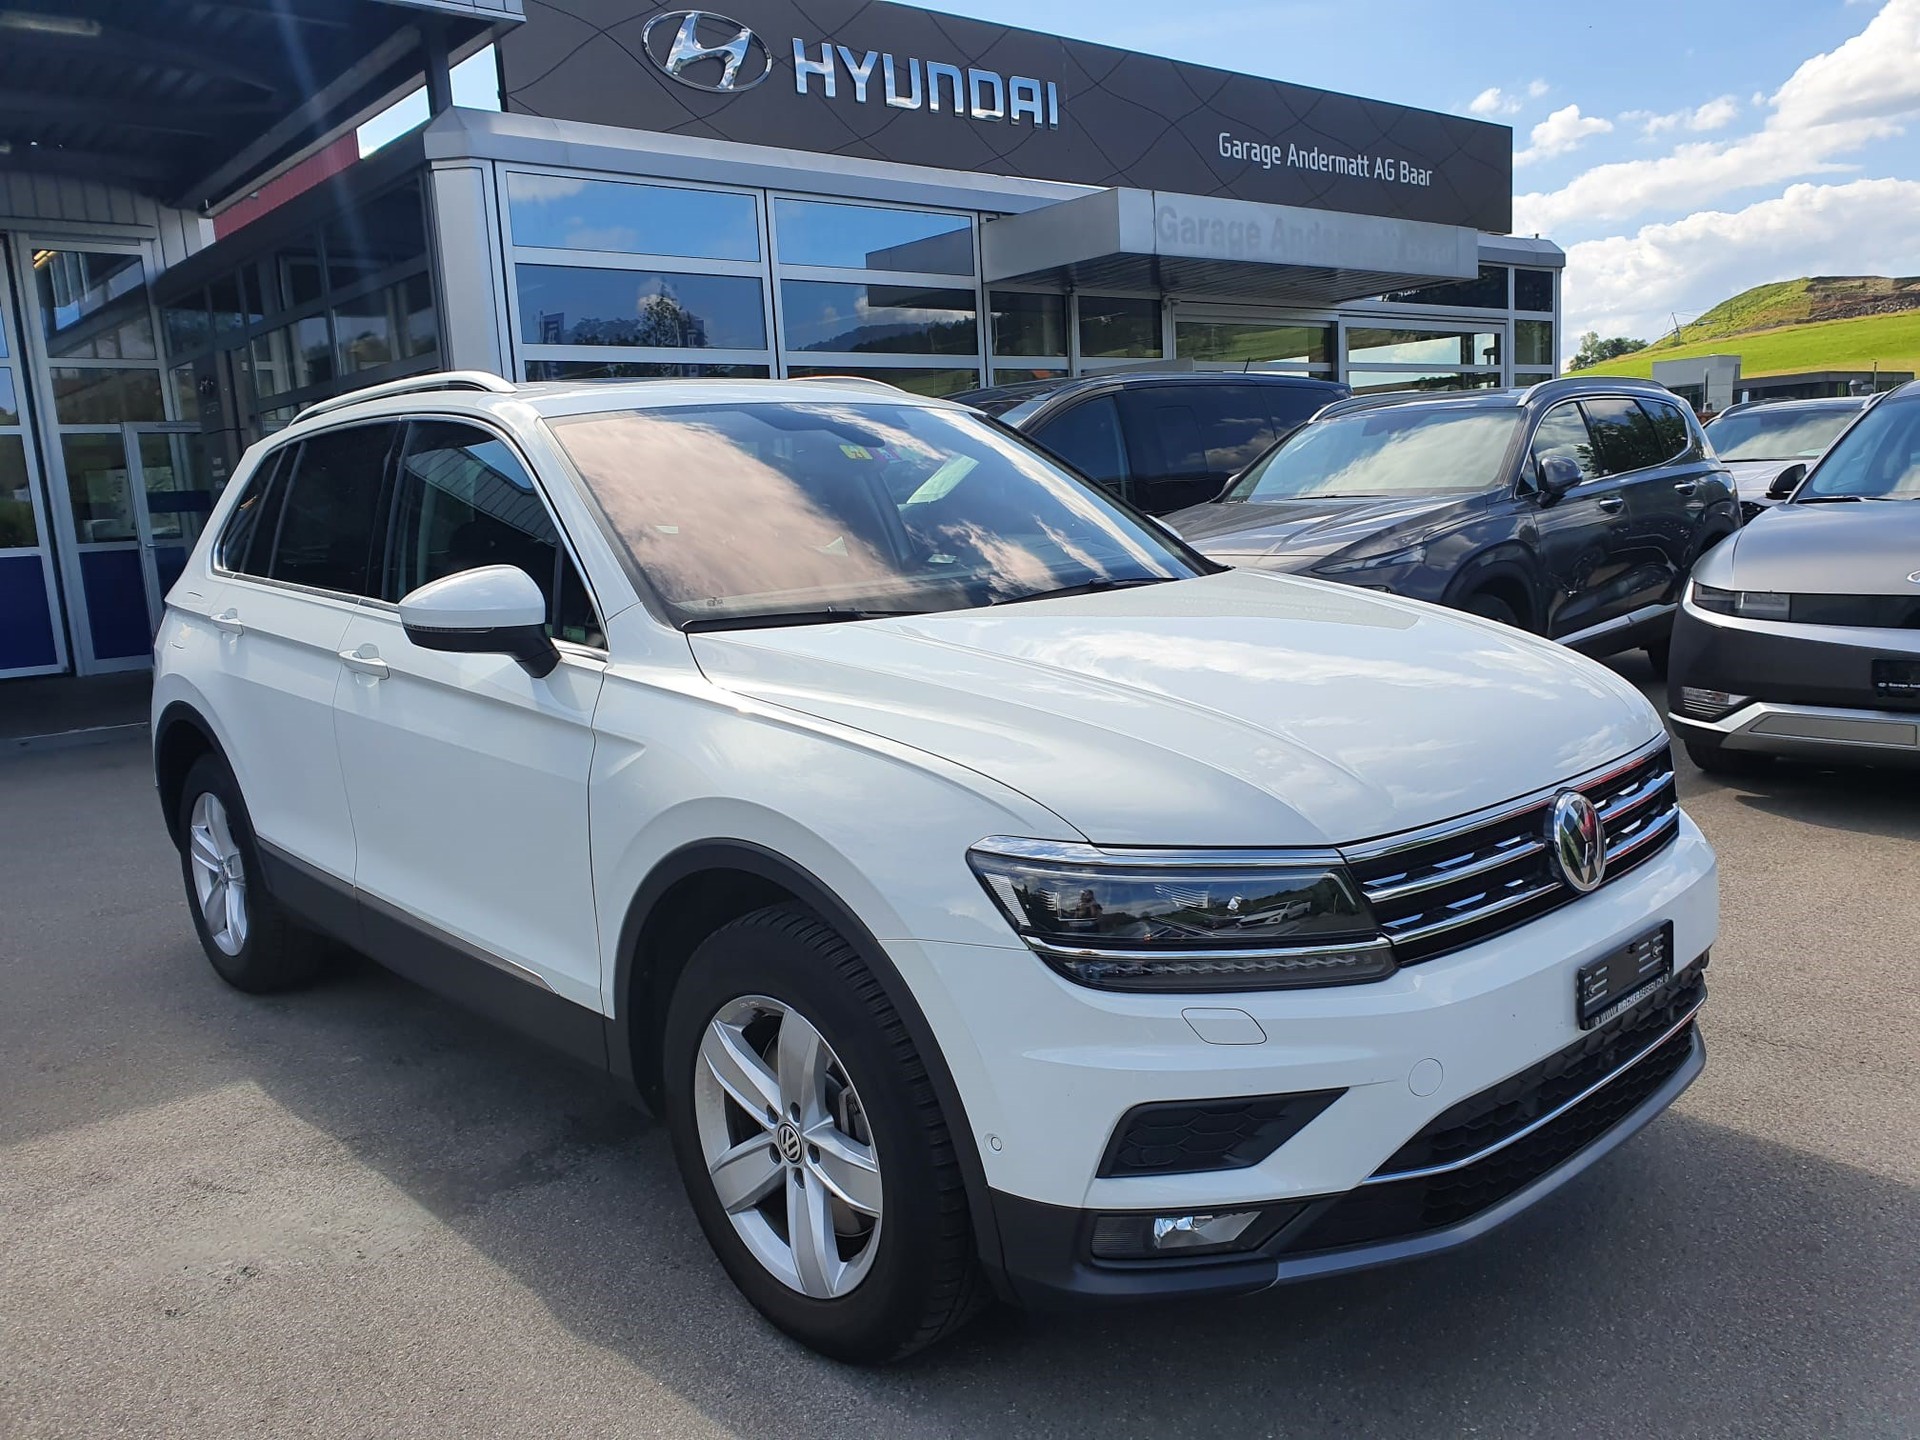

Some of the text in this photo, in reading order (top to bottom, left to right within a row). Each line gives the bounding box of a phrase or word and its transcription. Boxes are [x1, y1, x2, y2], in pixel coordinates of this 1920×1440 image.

[792, 37, 1059, 130] HYUNDAI
[1218, 132, 1433, 187] Garage Andermatt AG Baar
[1156, 204, 1262, 256] Garage
